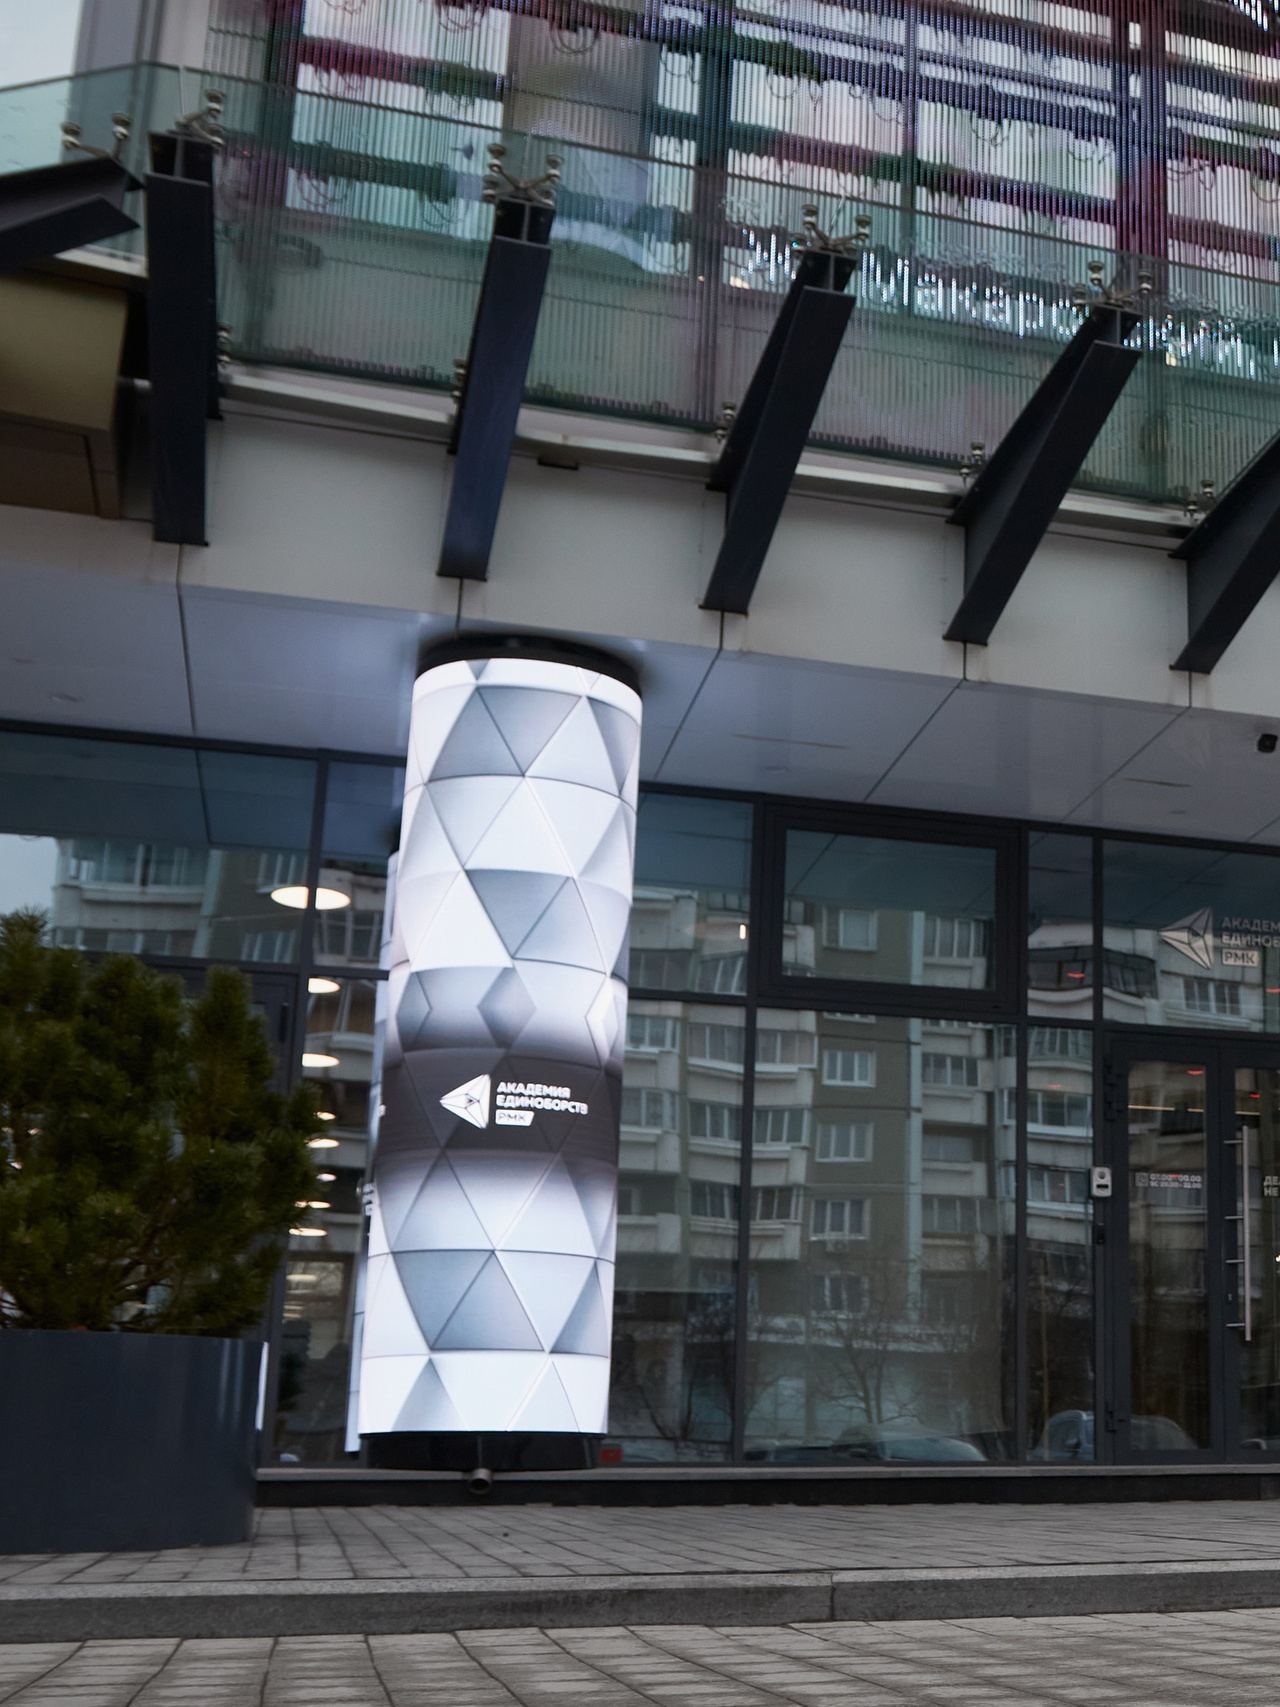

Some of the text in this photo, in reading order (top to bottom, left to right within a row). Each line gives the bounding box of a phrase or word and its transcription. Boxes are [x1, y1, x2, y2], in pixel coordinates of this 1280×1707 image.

[1224, 951, 1255, 964] РМК
[496, 1082, 571, 1099] АКАДЕМИЯ
[496, 1094, 588, 1114] ЕДИНОБОРСТВ
[499, 1112, 526, 1122] РМК
[1264, 1187, 1279, 1197] НЕ
